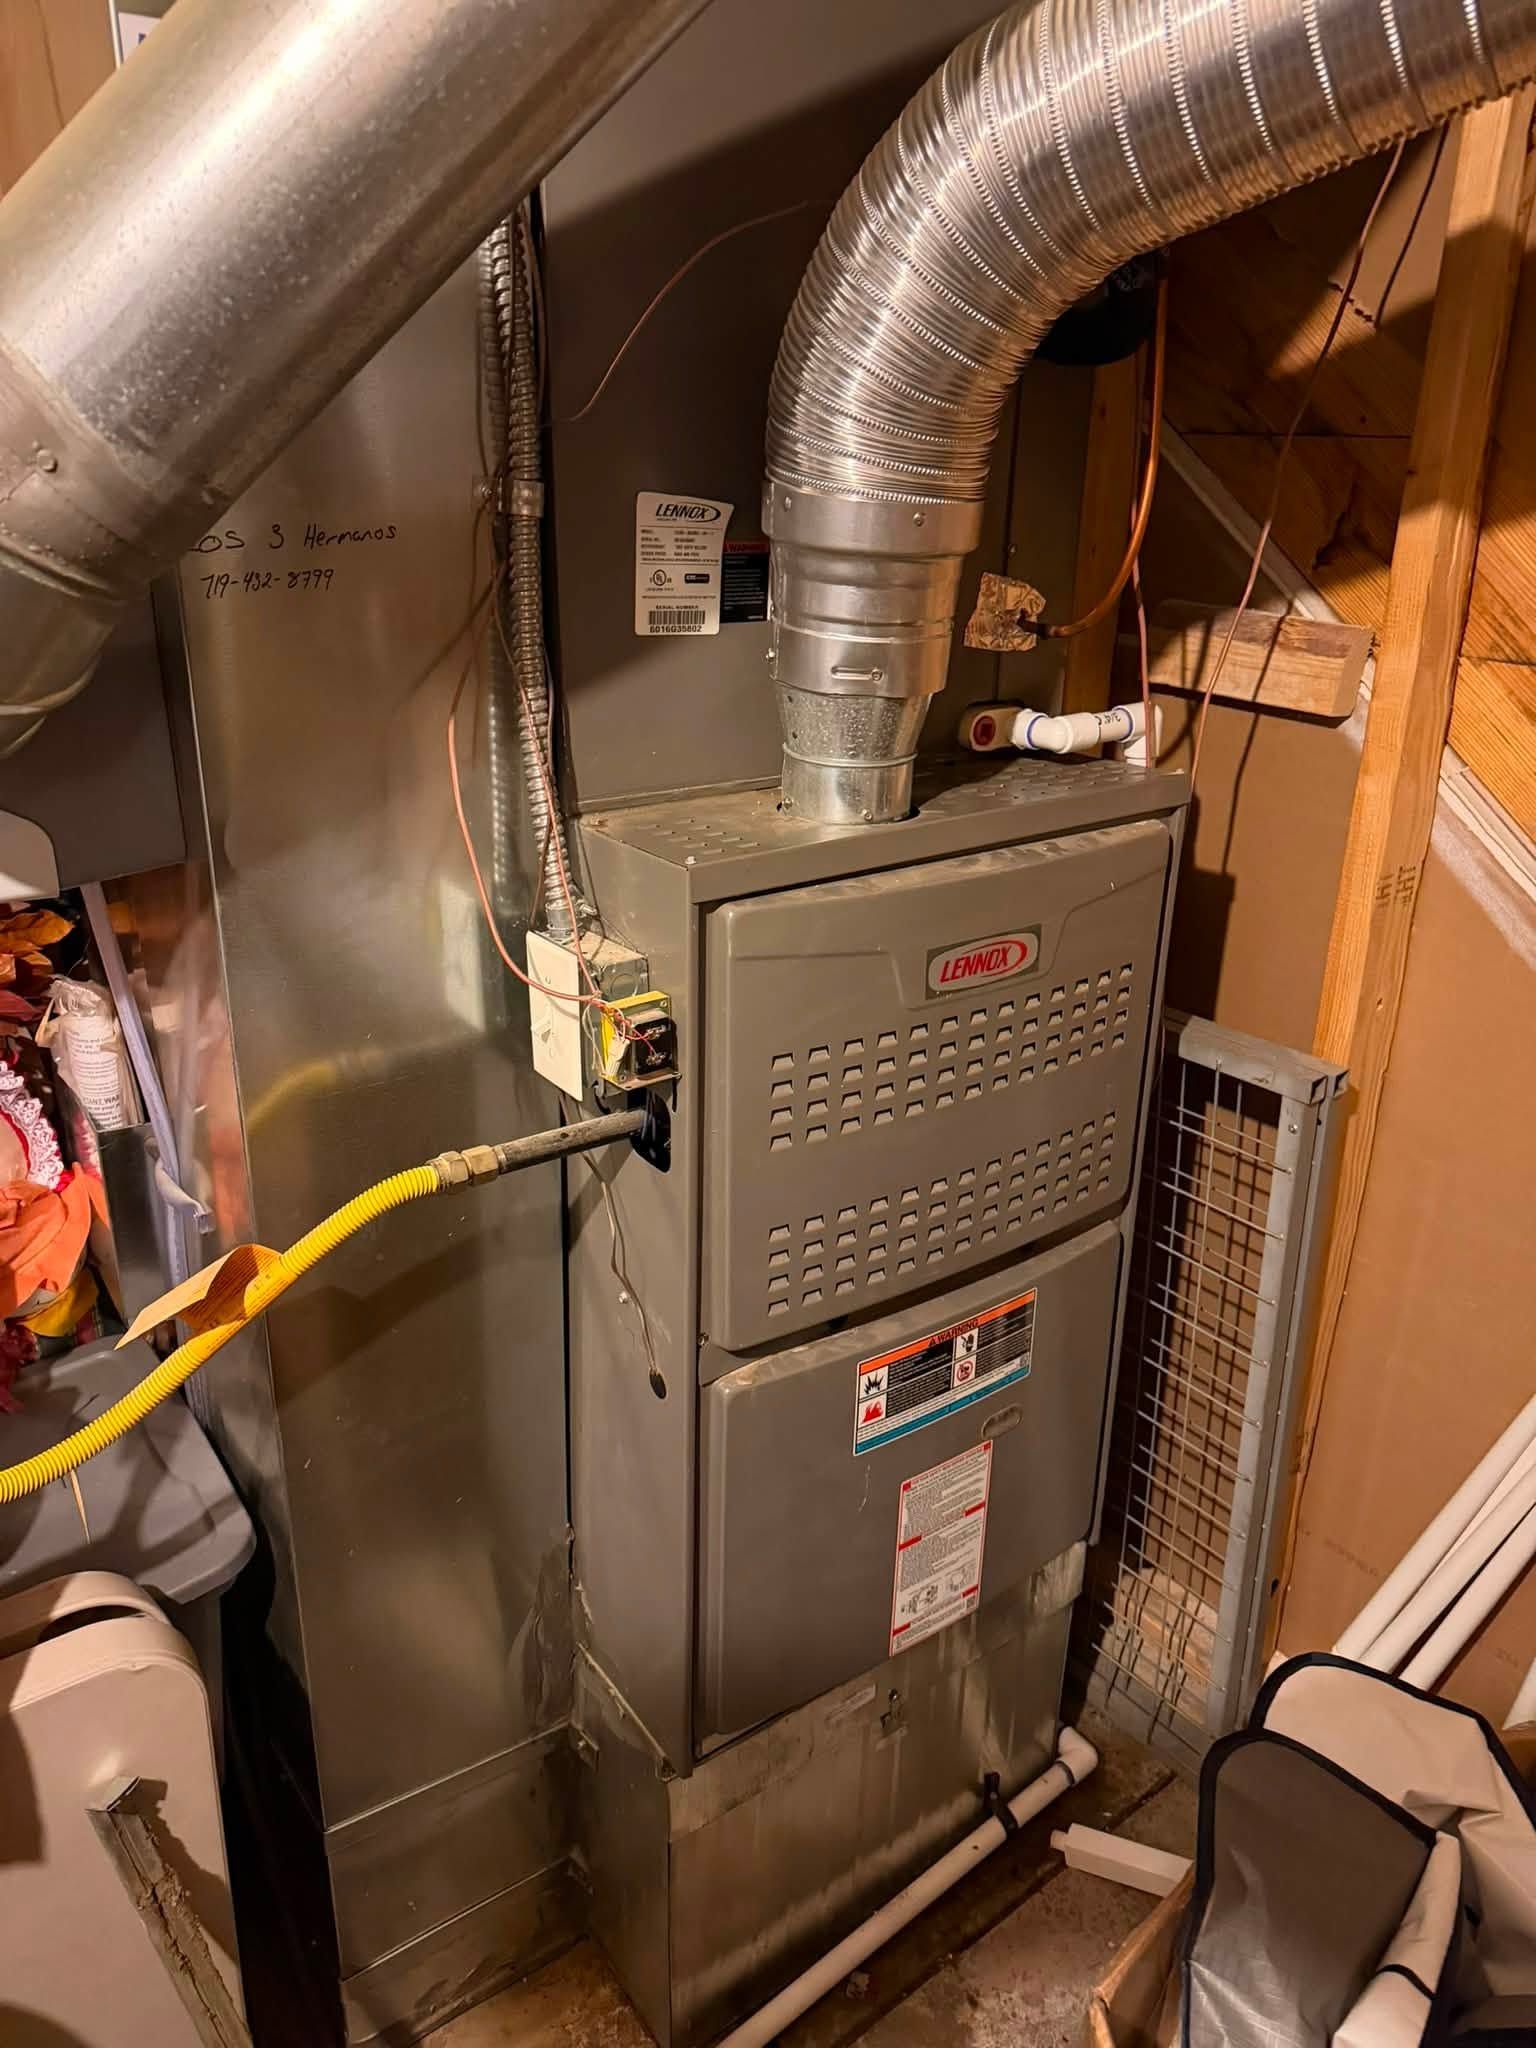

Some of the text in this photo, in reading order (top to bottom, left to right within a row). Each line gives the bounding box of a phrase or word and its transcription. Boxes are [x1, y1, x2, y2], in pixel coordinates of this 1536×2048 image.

[656, 503, 709, 519] LENNOX
[268, 523, 285, 549] 3
[303, 522, 398, 548] Hermanos
[939, 945, 1012, 984] LENNOX
[936, 1319, 979, 1341] WARNING
